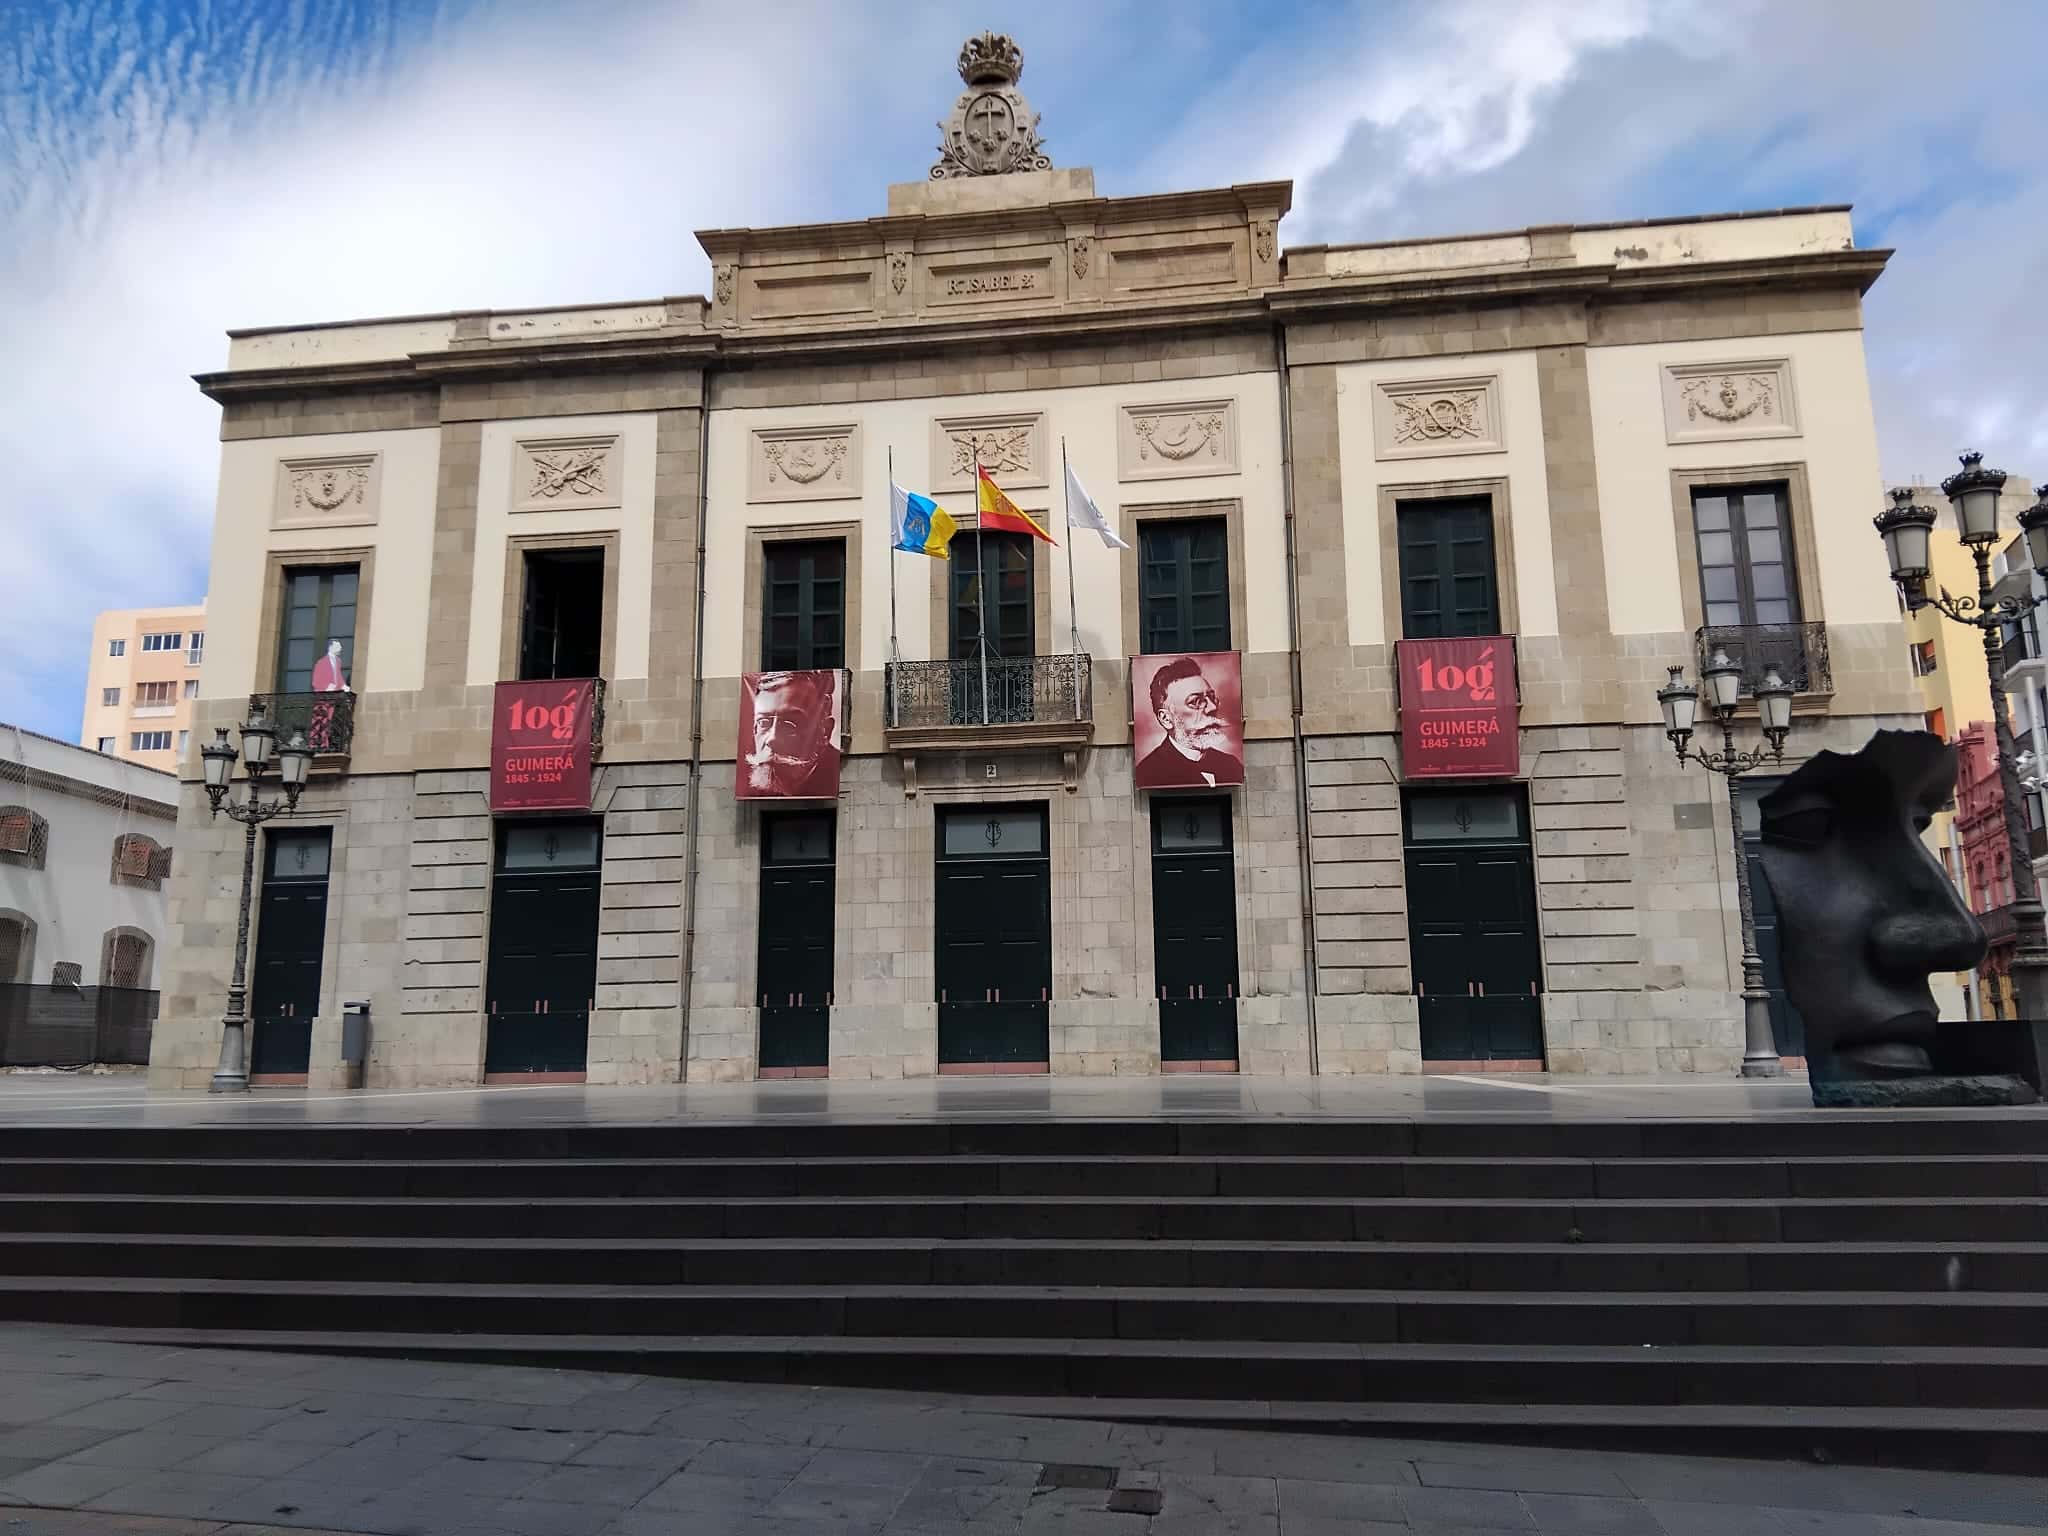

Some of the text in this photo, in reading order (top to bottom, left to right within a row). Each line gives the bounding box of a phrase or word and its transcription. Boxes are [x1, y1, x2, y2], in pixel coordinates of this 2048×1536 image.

[1420, 716, 1500, 736] GUIMERÁ
[1421, 738, 1449, 749] 1845
[1459, 737, 1487, 748] 1924
[505, 753, 575, 772] GUIMERÁ
[505, 774, 529, 784] 1845
[537, 772, 562, 783] 1924
